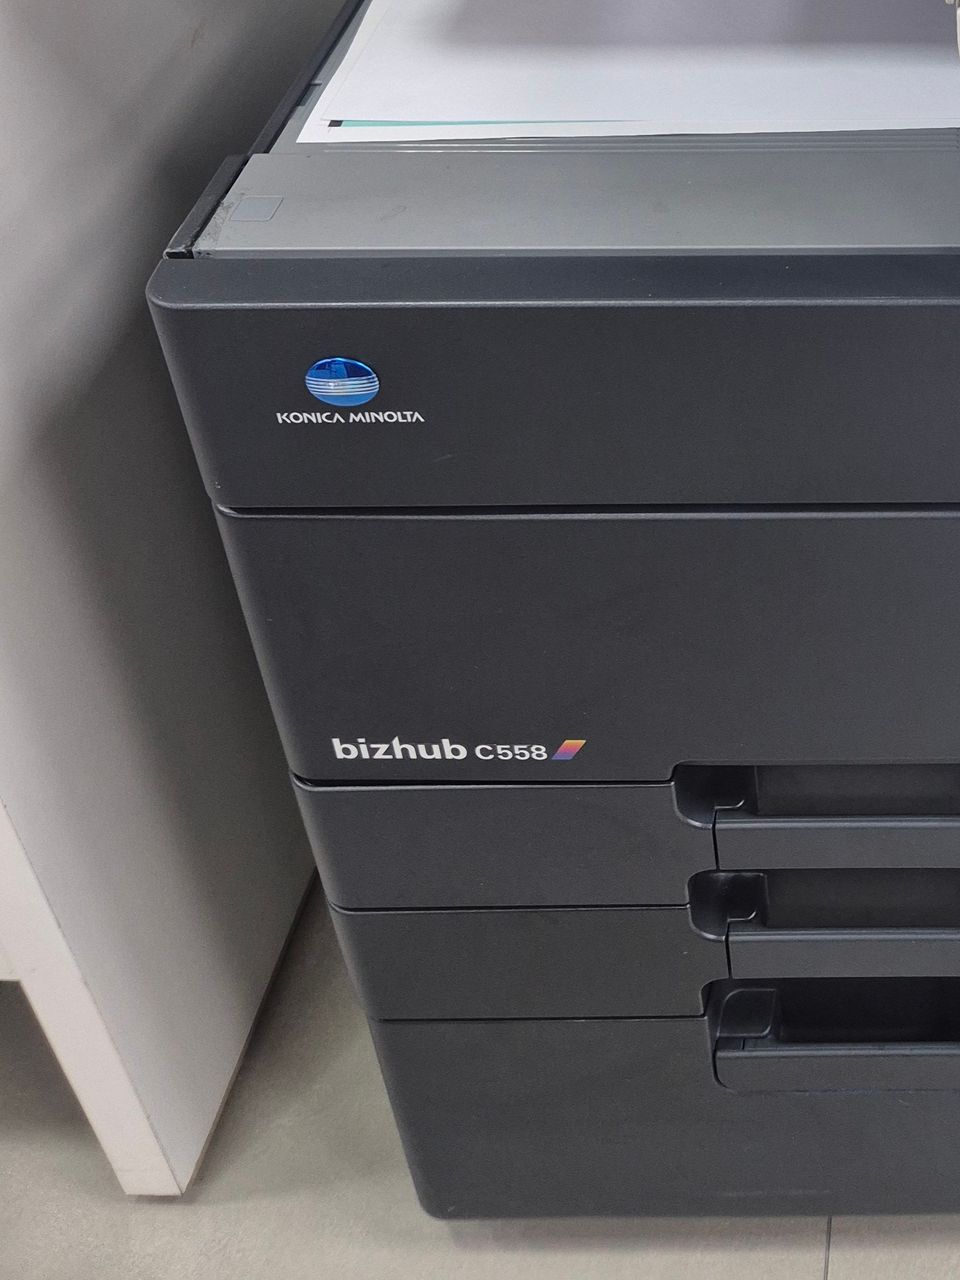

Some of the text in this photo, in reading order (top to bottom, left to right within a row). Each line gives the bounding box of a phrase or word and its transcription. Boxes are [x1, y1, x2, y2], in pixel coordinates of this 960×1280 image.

[276, 411, 425, 424] KONICA MINOLTA
[331, 736, 549, 761] bizhub C558
